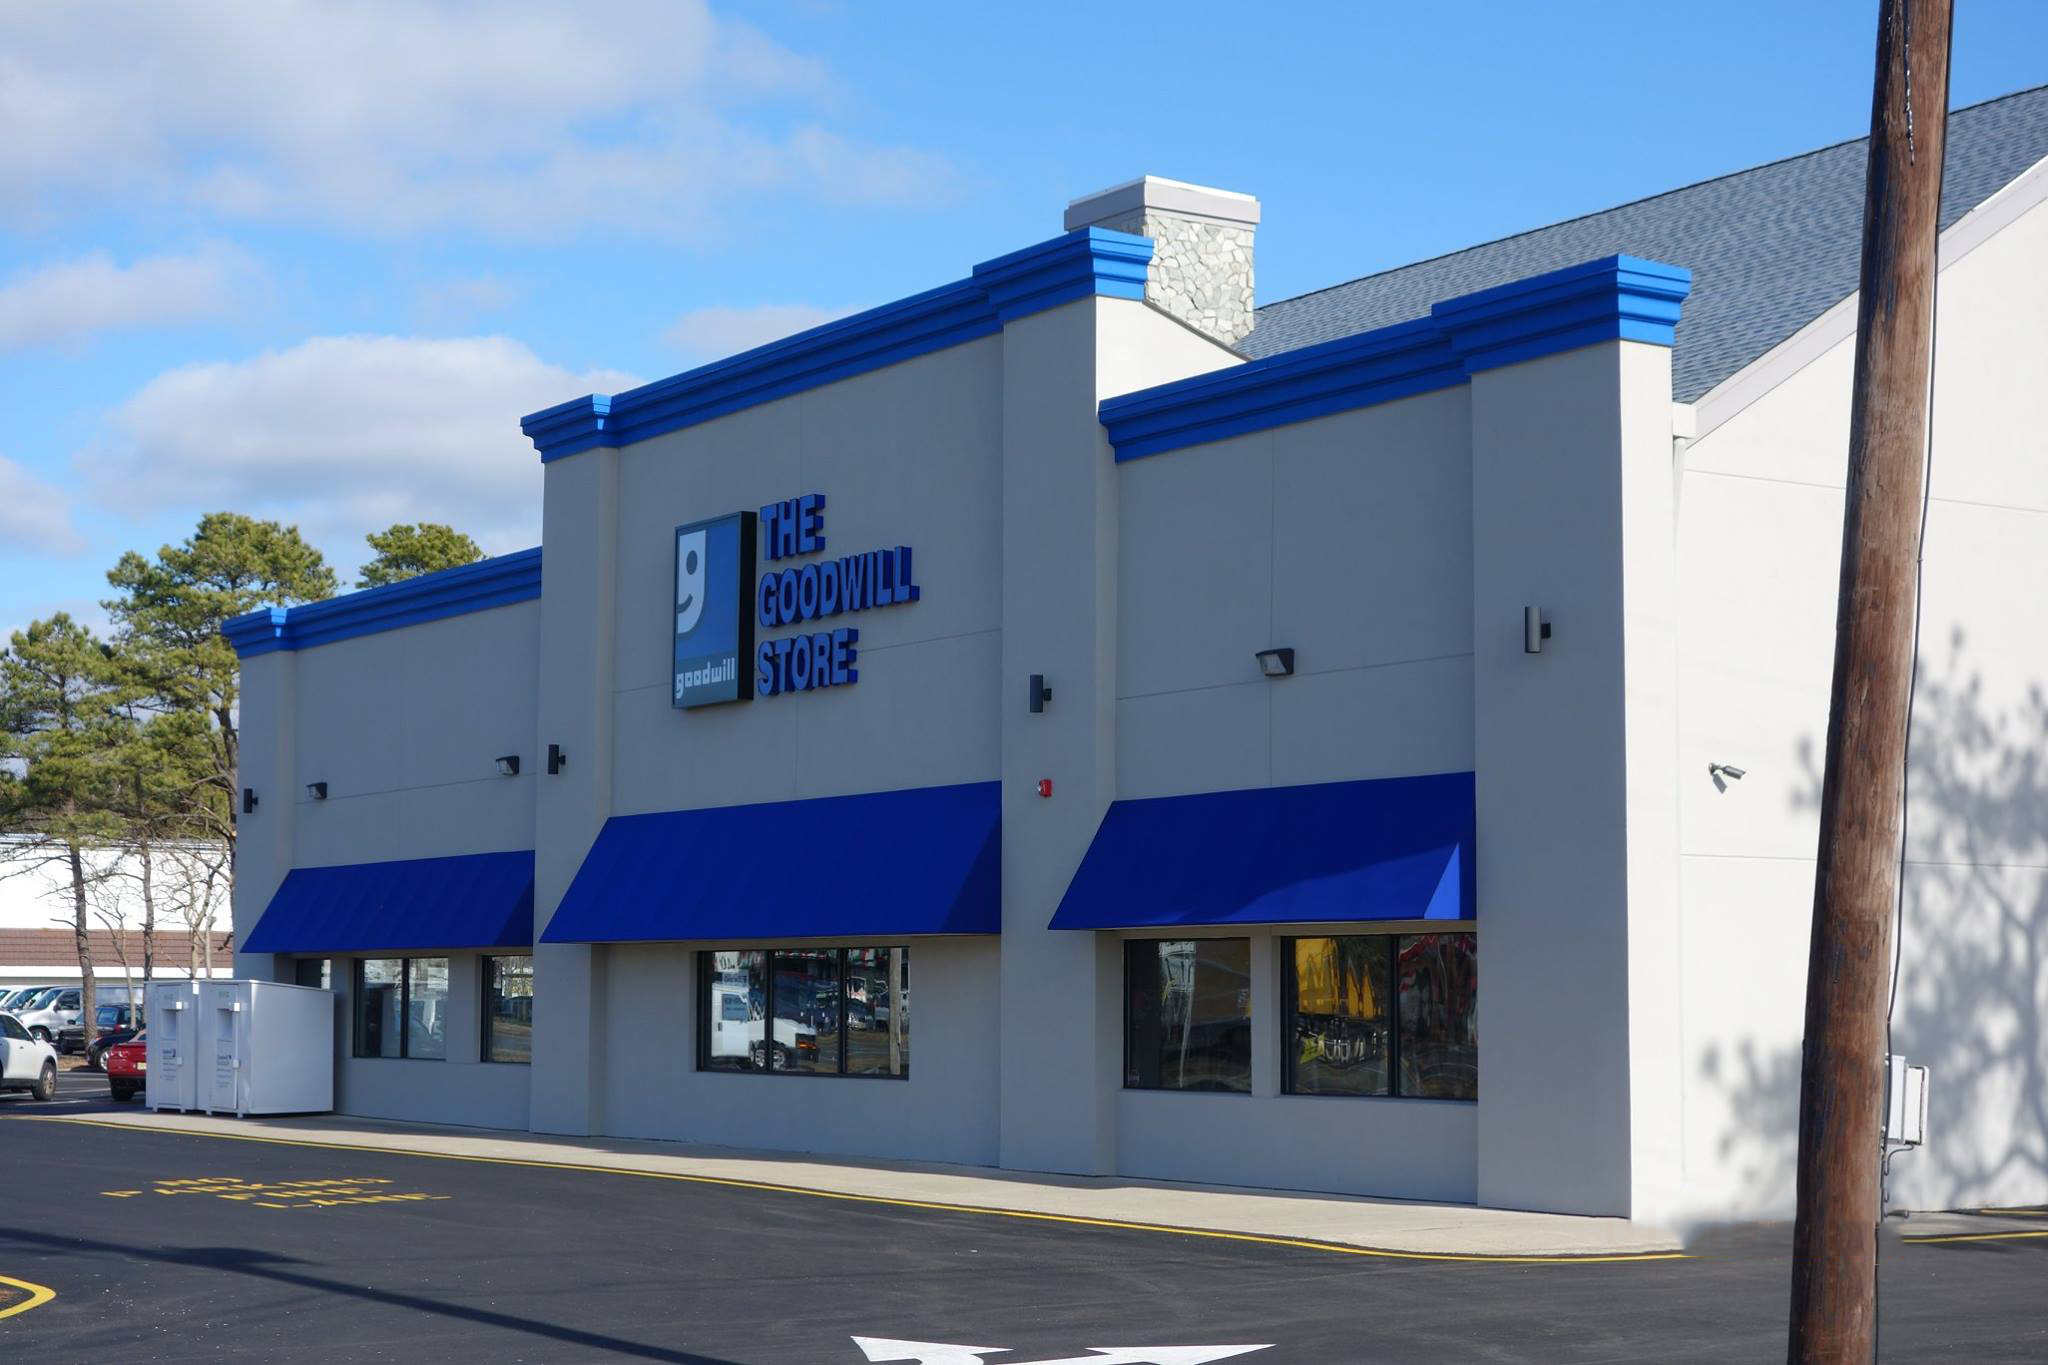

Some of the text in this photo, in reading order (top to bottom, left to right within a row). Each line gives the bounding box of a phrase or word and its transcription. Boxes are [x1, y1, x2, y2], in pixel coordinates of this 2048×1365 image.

[760, 493, 825, 561] THE
[759, 546, 920, 627] GOODWILL
[676, 657, 736, 699] goodwill
[758, 628, 859, 697] STORE
